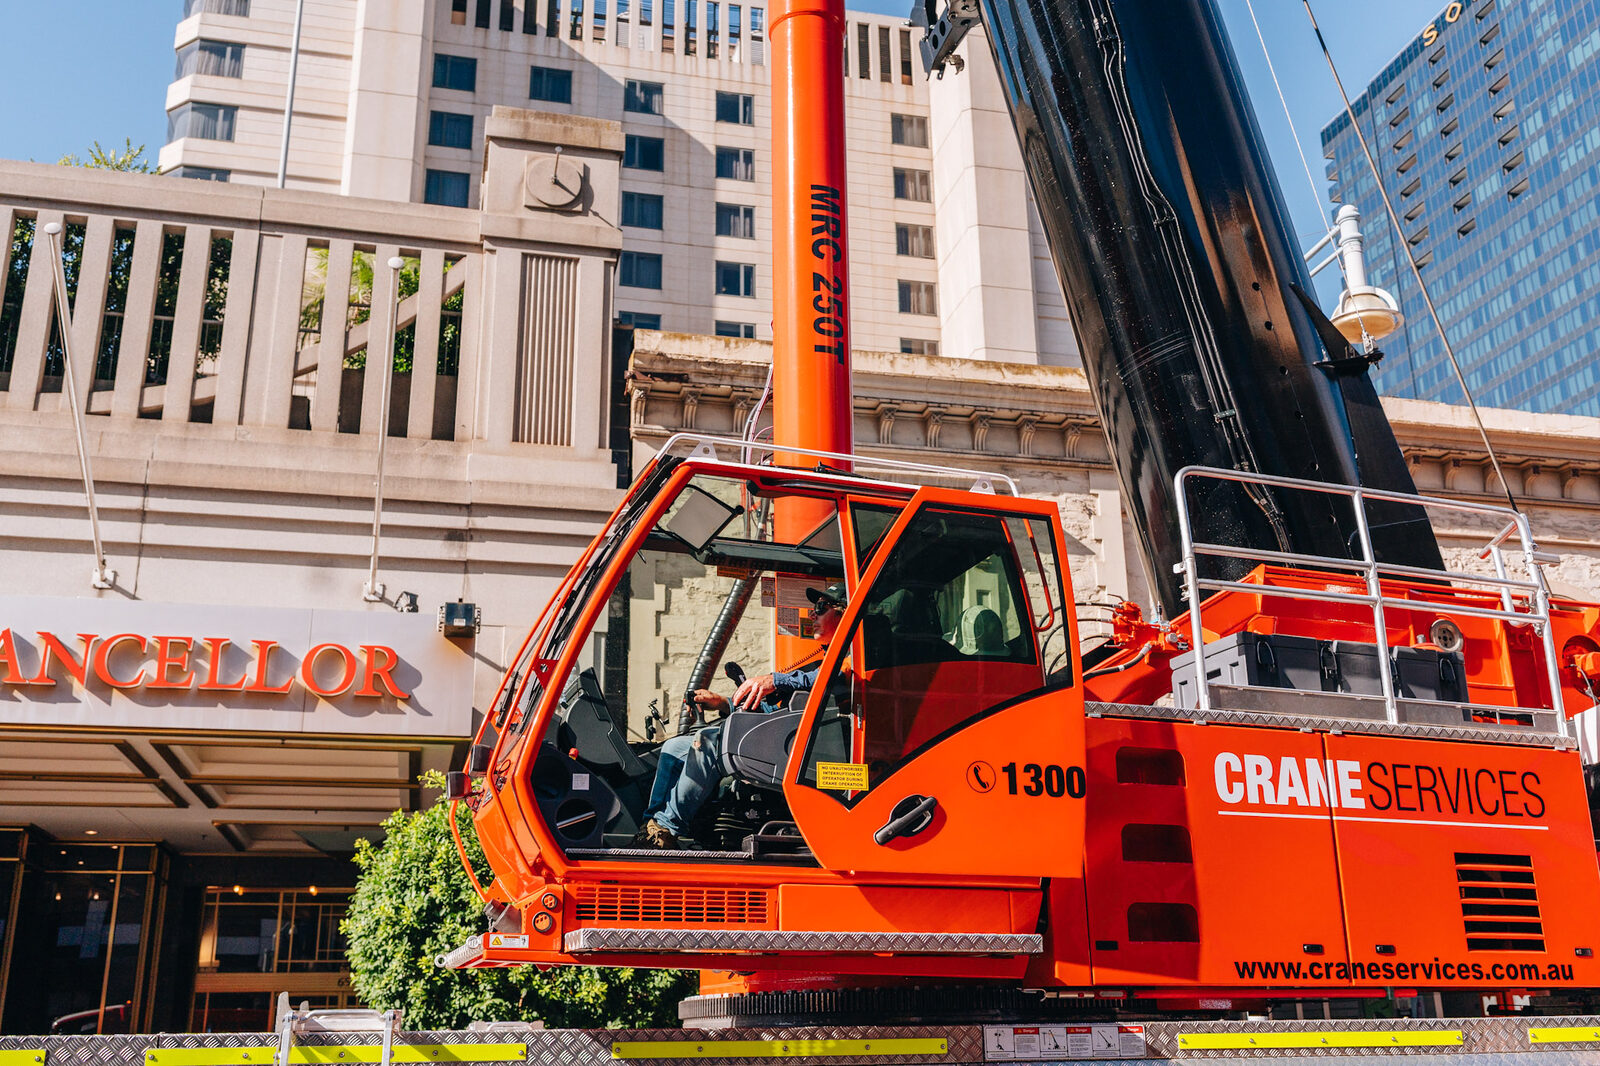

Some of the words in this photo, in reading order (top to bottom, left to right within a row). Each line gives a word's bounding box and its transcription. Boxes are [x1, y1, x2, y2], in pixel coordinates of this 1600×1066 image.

[1422, 0, 1478, 46] SO
[811, 184, 842, 263] MRC
[812, 271, 845, 365] 250T
[0, 627, 411, 700] ANCELLOR
[1001, 761, 1087, 799] 1300
[1214, 751, 1366, 810] CRANE
[1366, 760, 1546, 819] SERVICES
[1233, 957, 1575, 982] www.craneservices.com.au
